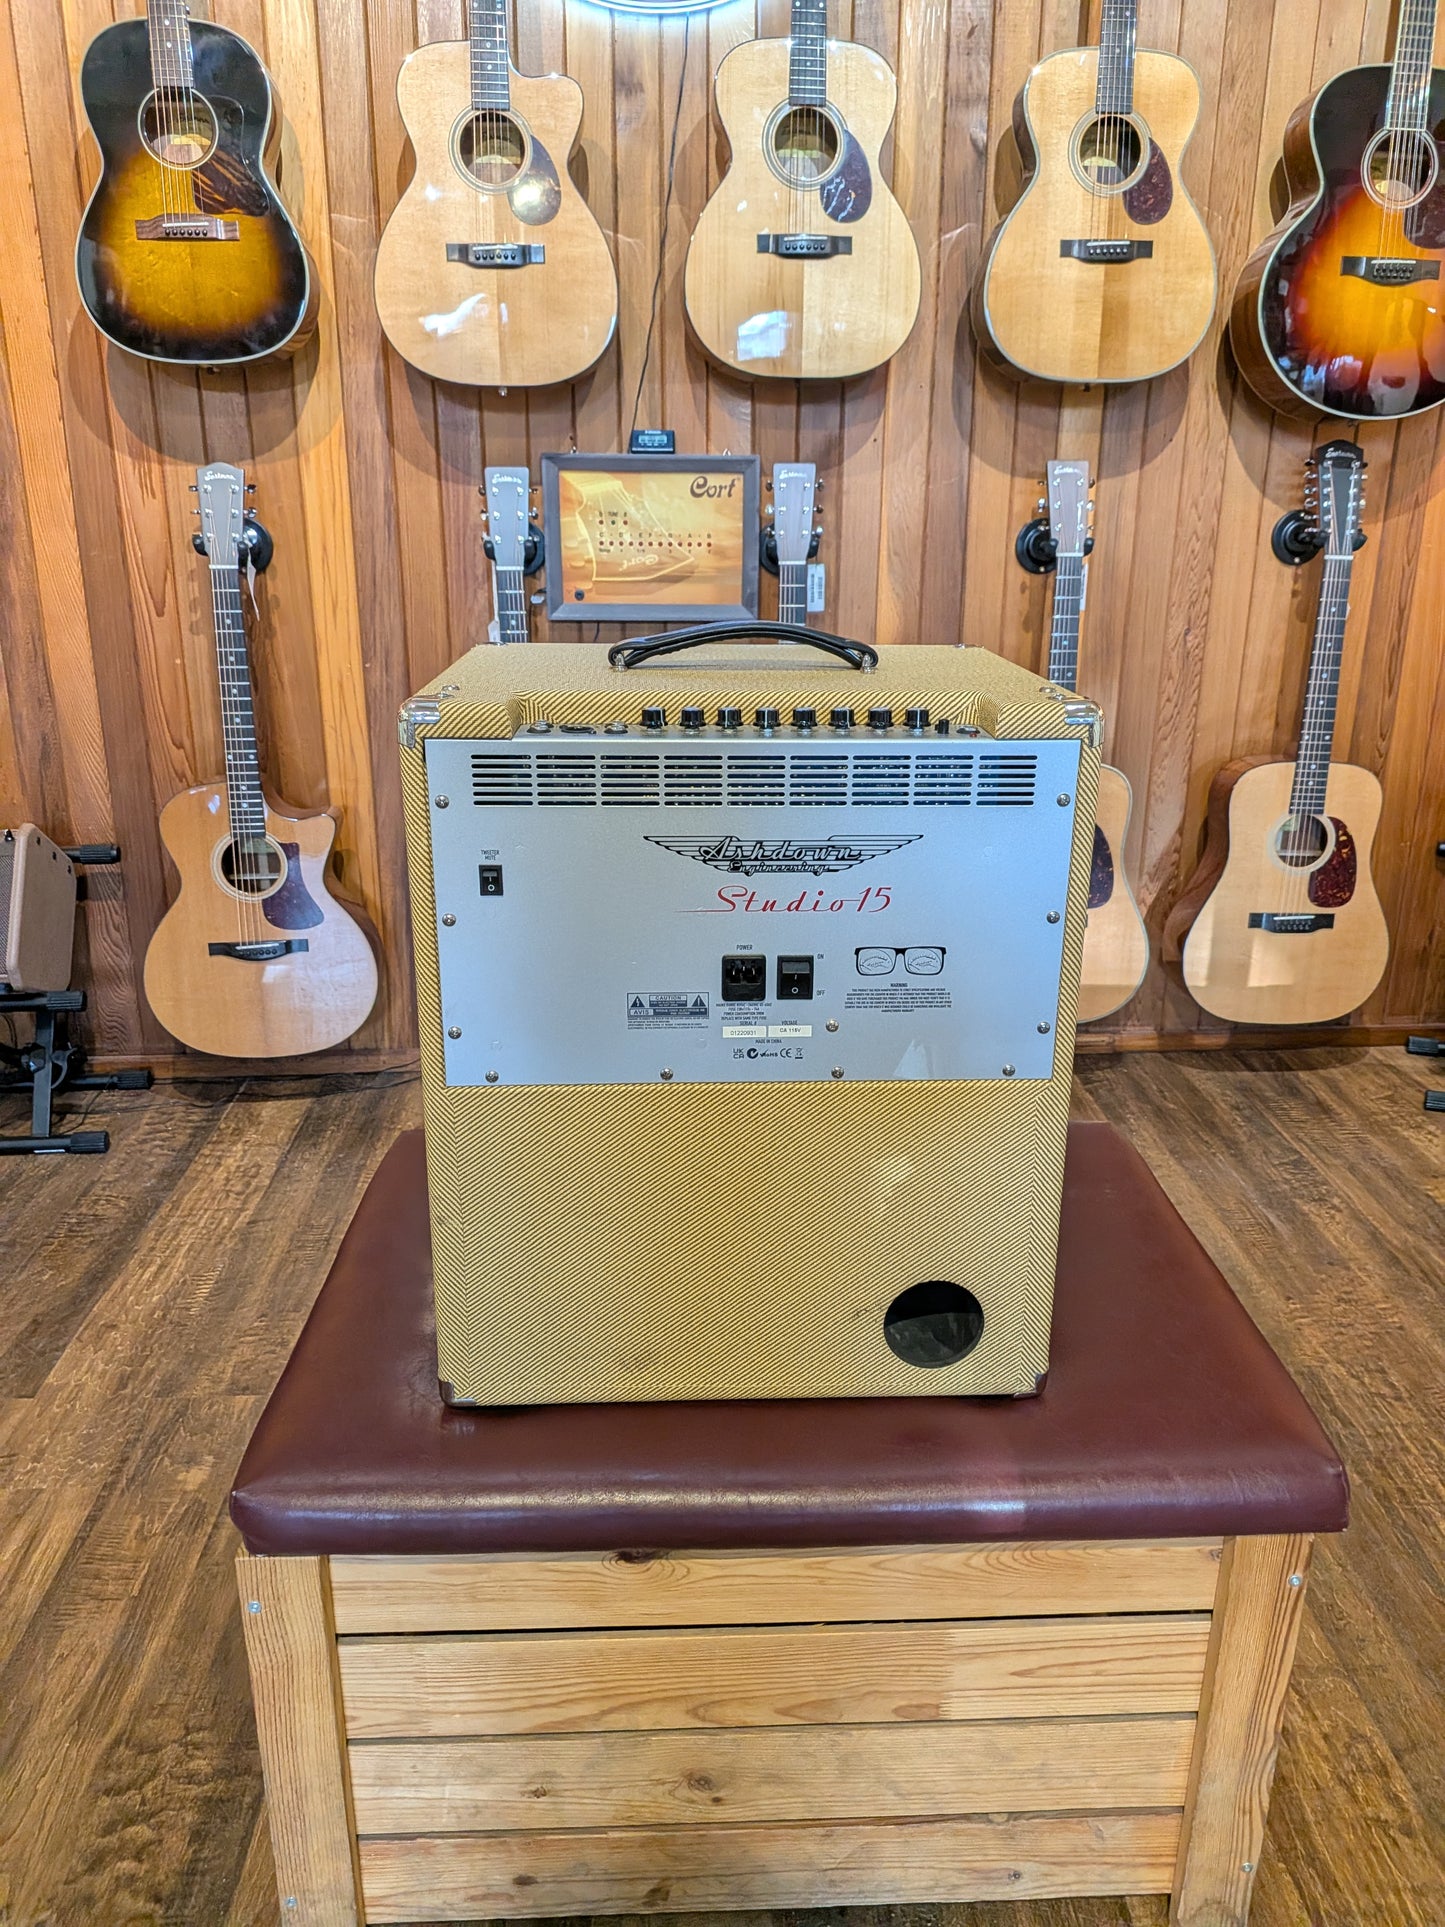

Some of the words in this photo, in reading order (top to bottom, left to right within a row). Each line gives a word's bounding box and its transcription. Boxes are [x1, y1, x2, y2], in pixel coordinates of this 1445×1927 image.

[690, 476, 736, 498] Cort
[699, 836, 861, 861] Ashdown
[674, 885, 850, 913] Studio
[856, 886, 892, 913] 15
